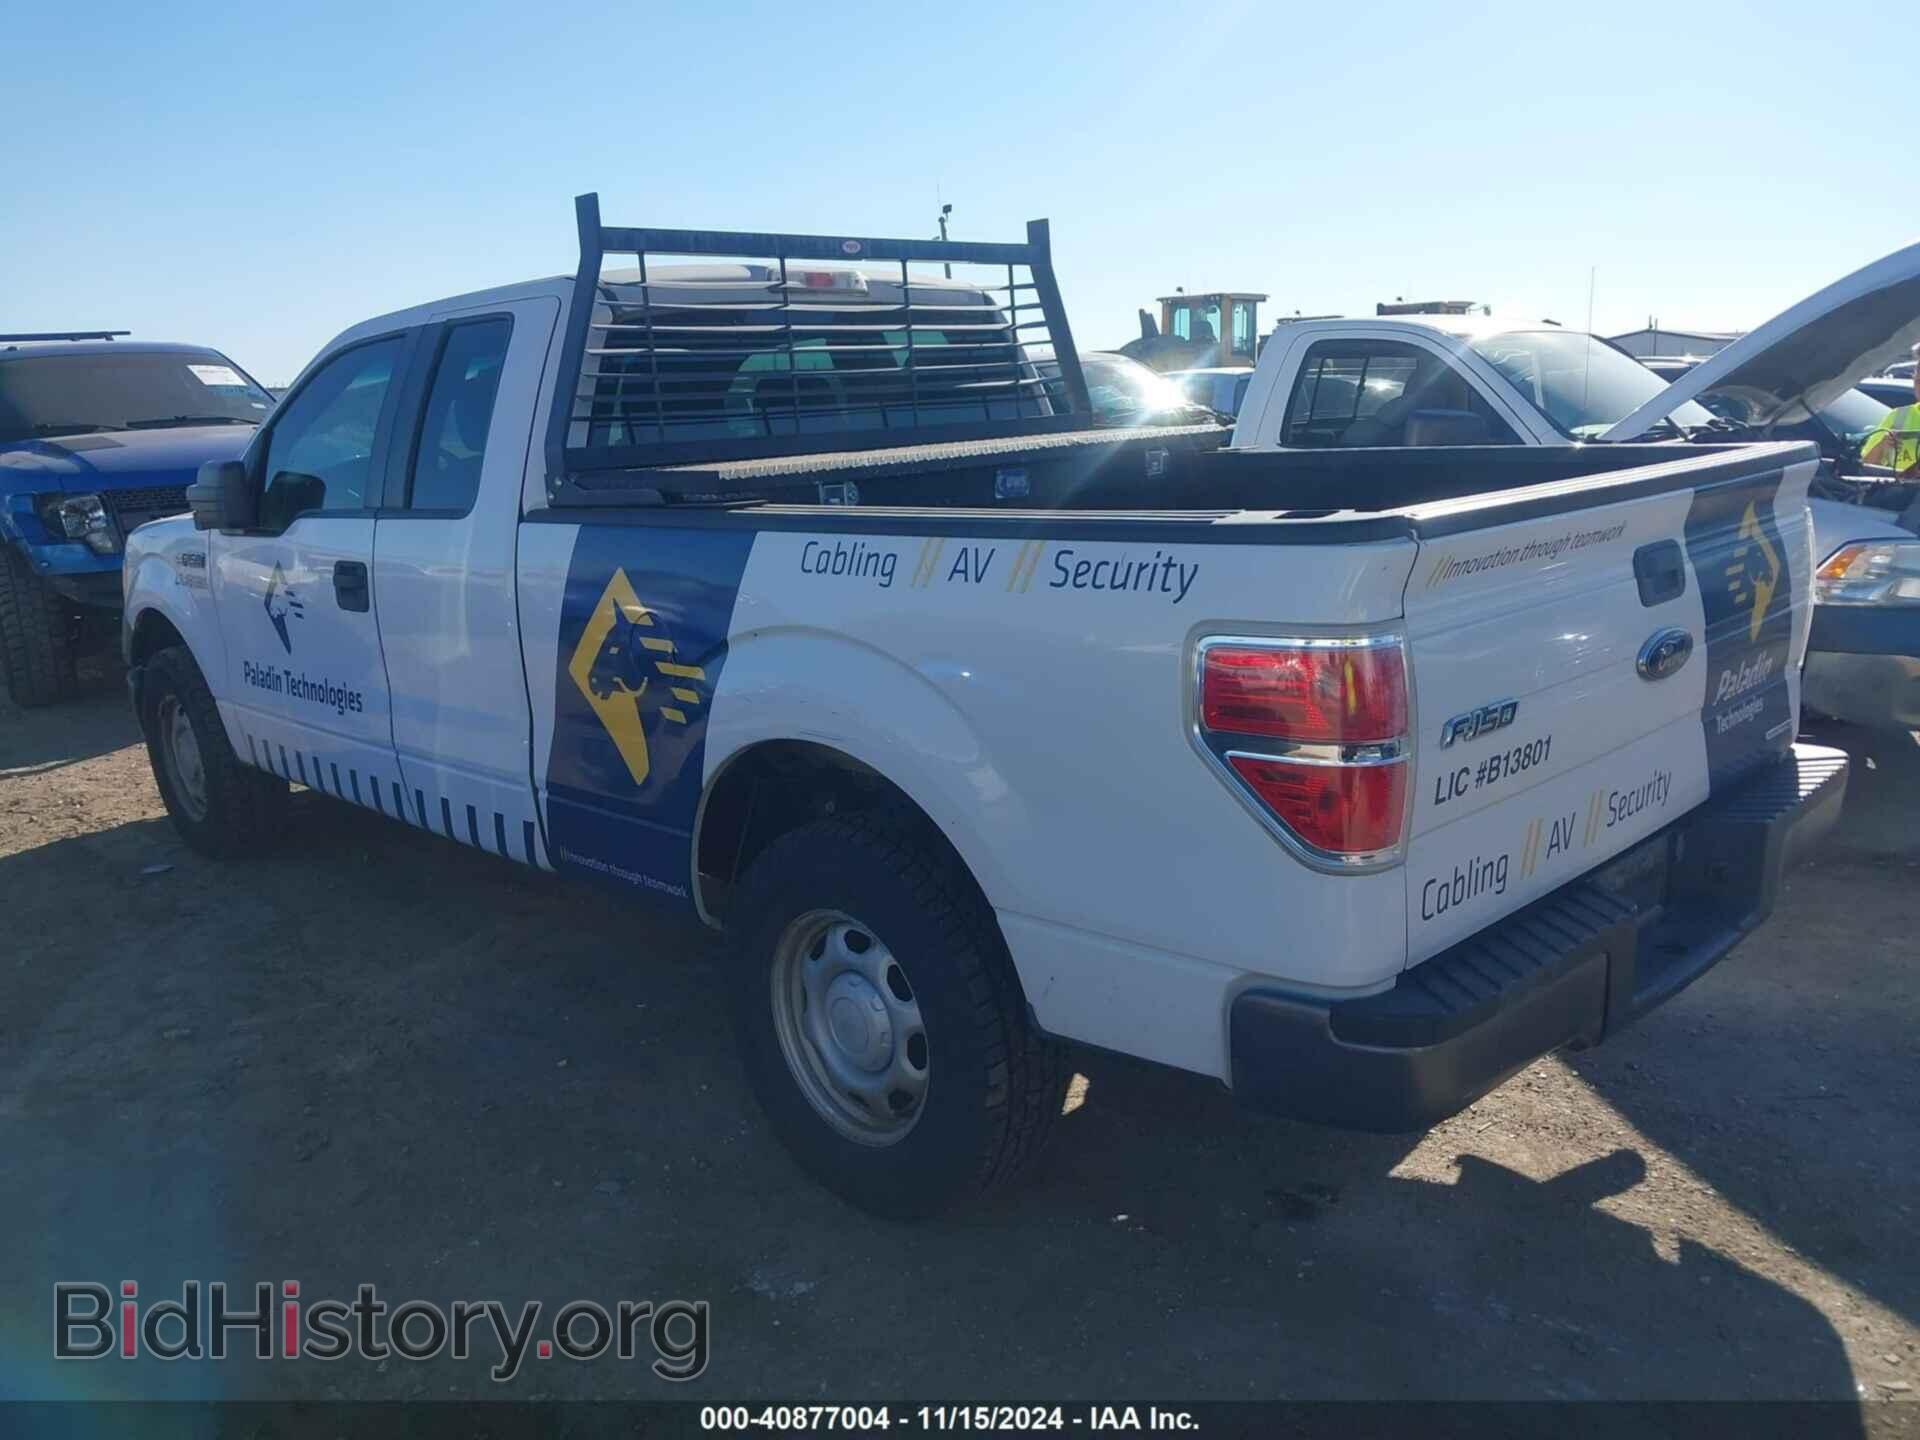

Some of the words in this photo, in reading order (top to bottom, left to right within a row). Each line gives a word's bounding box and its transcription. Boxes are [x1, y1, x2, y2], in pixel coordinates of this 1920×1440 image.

[1520, 531, 1571, 561] through
[1570, 520, 1629, 550] teamwork
[800, 541, 898, 588] Cabling
[947, 547, 997, 584] AV
[1049, 549, 1199, 604] Security
[243, 660, 282, 693] Paladin
[283, 670, 363, 715] Technologies
[1713, 651, 1774, 706] Paladin
[1716, 696, 1764, 735] Technologies
[1434, 767, 1470, 805] LIC
[1475, 735, 1552, 789] #B13801
[1422, 854, 1509, 921] Cabling
[1547, 812, 1576, 860] AV
[1607, 771, 1672, 827] Security
[609, 864, 642, 886] through
[642, 875, 689, 898] teamwork
